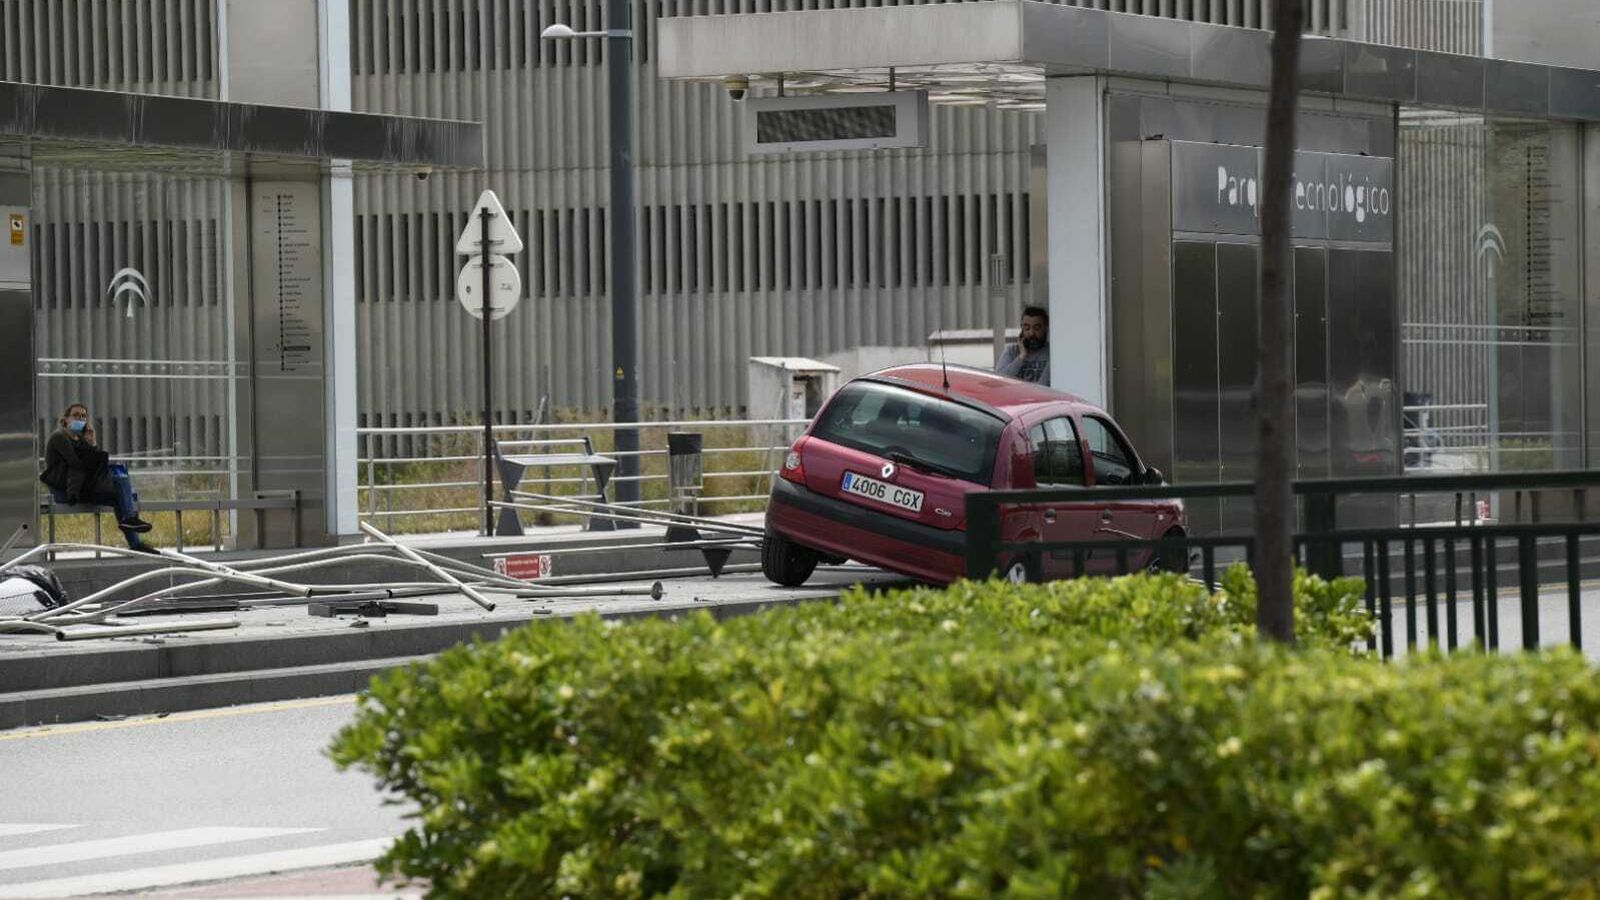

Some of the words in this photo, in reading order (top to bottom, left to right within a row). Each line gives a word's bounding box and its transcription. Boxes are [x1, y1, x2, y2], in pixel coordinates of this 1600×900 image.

[1217, 165, 1258, 217] Parq
[1290, 172, 1389, 223] ecnológico
[852, 477, 887, 498] 4006
[893, 489, 921, 509] CGX
